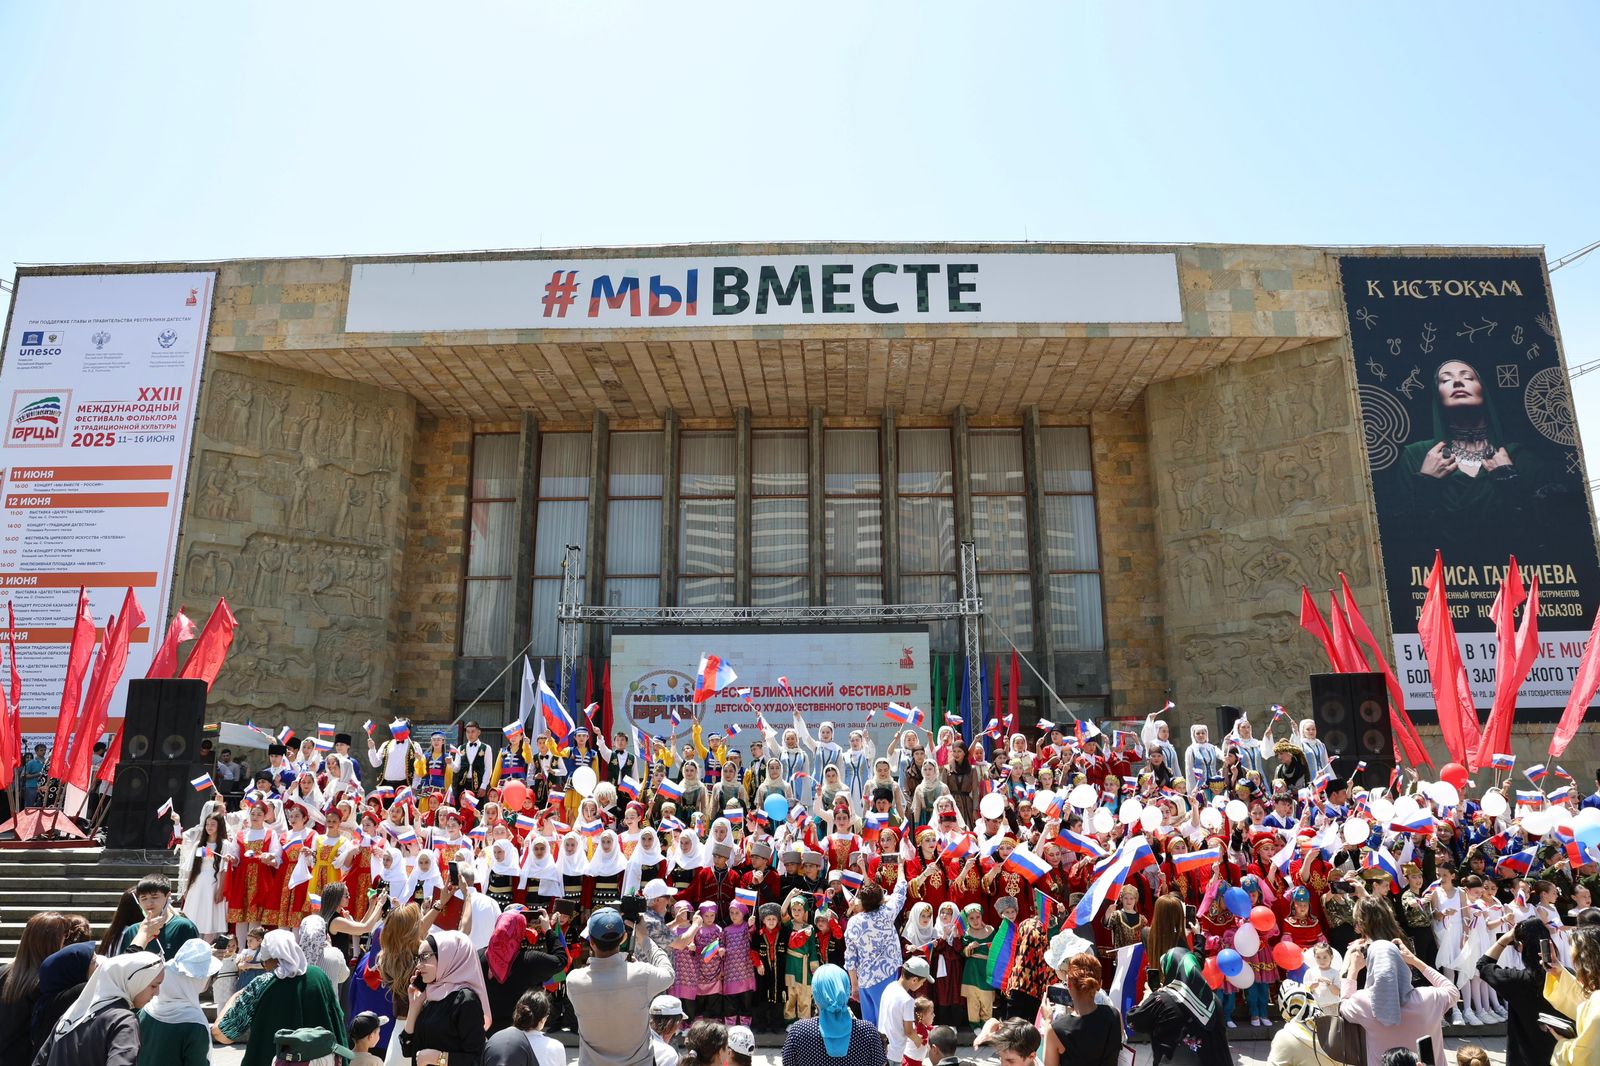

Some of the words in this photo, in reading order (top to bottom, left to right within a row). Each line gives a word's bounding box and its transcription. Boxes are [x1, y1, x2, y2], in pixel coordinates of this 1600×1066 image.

[1366, 280, 1384, 299] К
[1392, 279, 1524, 299] ИСТОКАМ
[20, 348, 62, 356] unesco
[137, 387, 182, 402] XXIII
[77, 402, 180, 413] МЕЖДУНАРОДНЫЙ
[12, 427, 60, 442] ГОРЦЫ
[70, 432, 116, 448] 2025
[23, 470, 54, 478] ИЮНЯ
[20, 497, 51, 506] ИЮНЯ
[6, 576, 38, 585] ИЮНЯ
[1410, 565, 1479, 586] ЛАИСА
[1404, 644, 1412, 660] 5
[1466, 644, 1474, 660] В
[1472, 668, 1496, 682] ЗАЛ
[839, 685, 911, 697] ФЕСТИВАЛЬ
[714, 704, 762, 714] ДЕТСКОГО
[764, 702, 854, 712] ХУДОЖЕСТВЕННОГО
